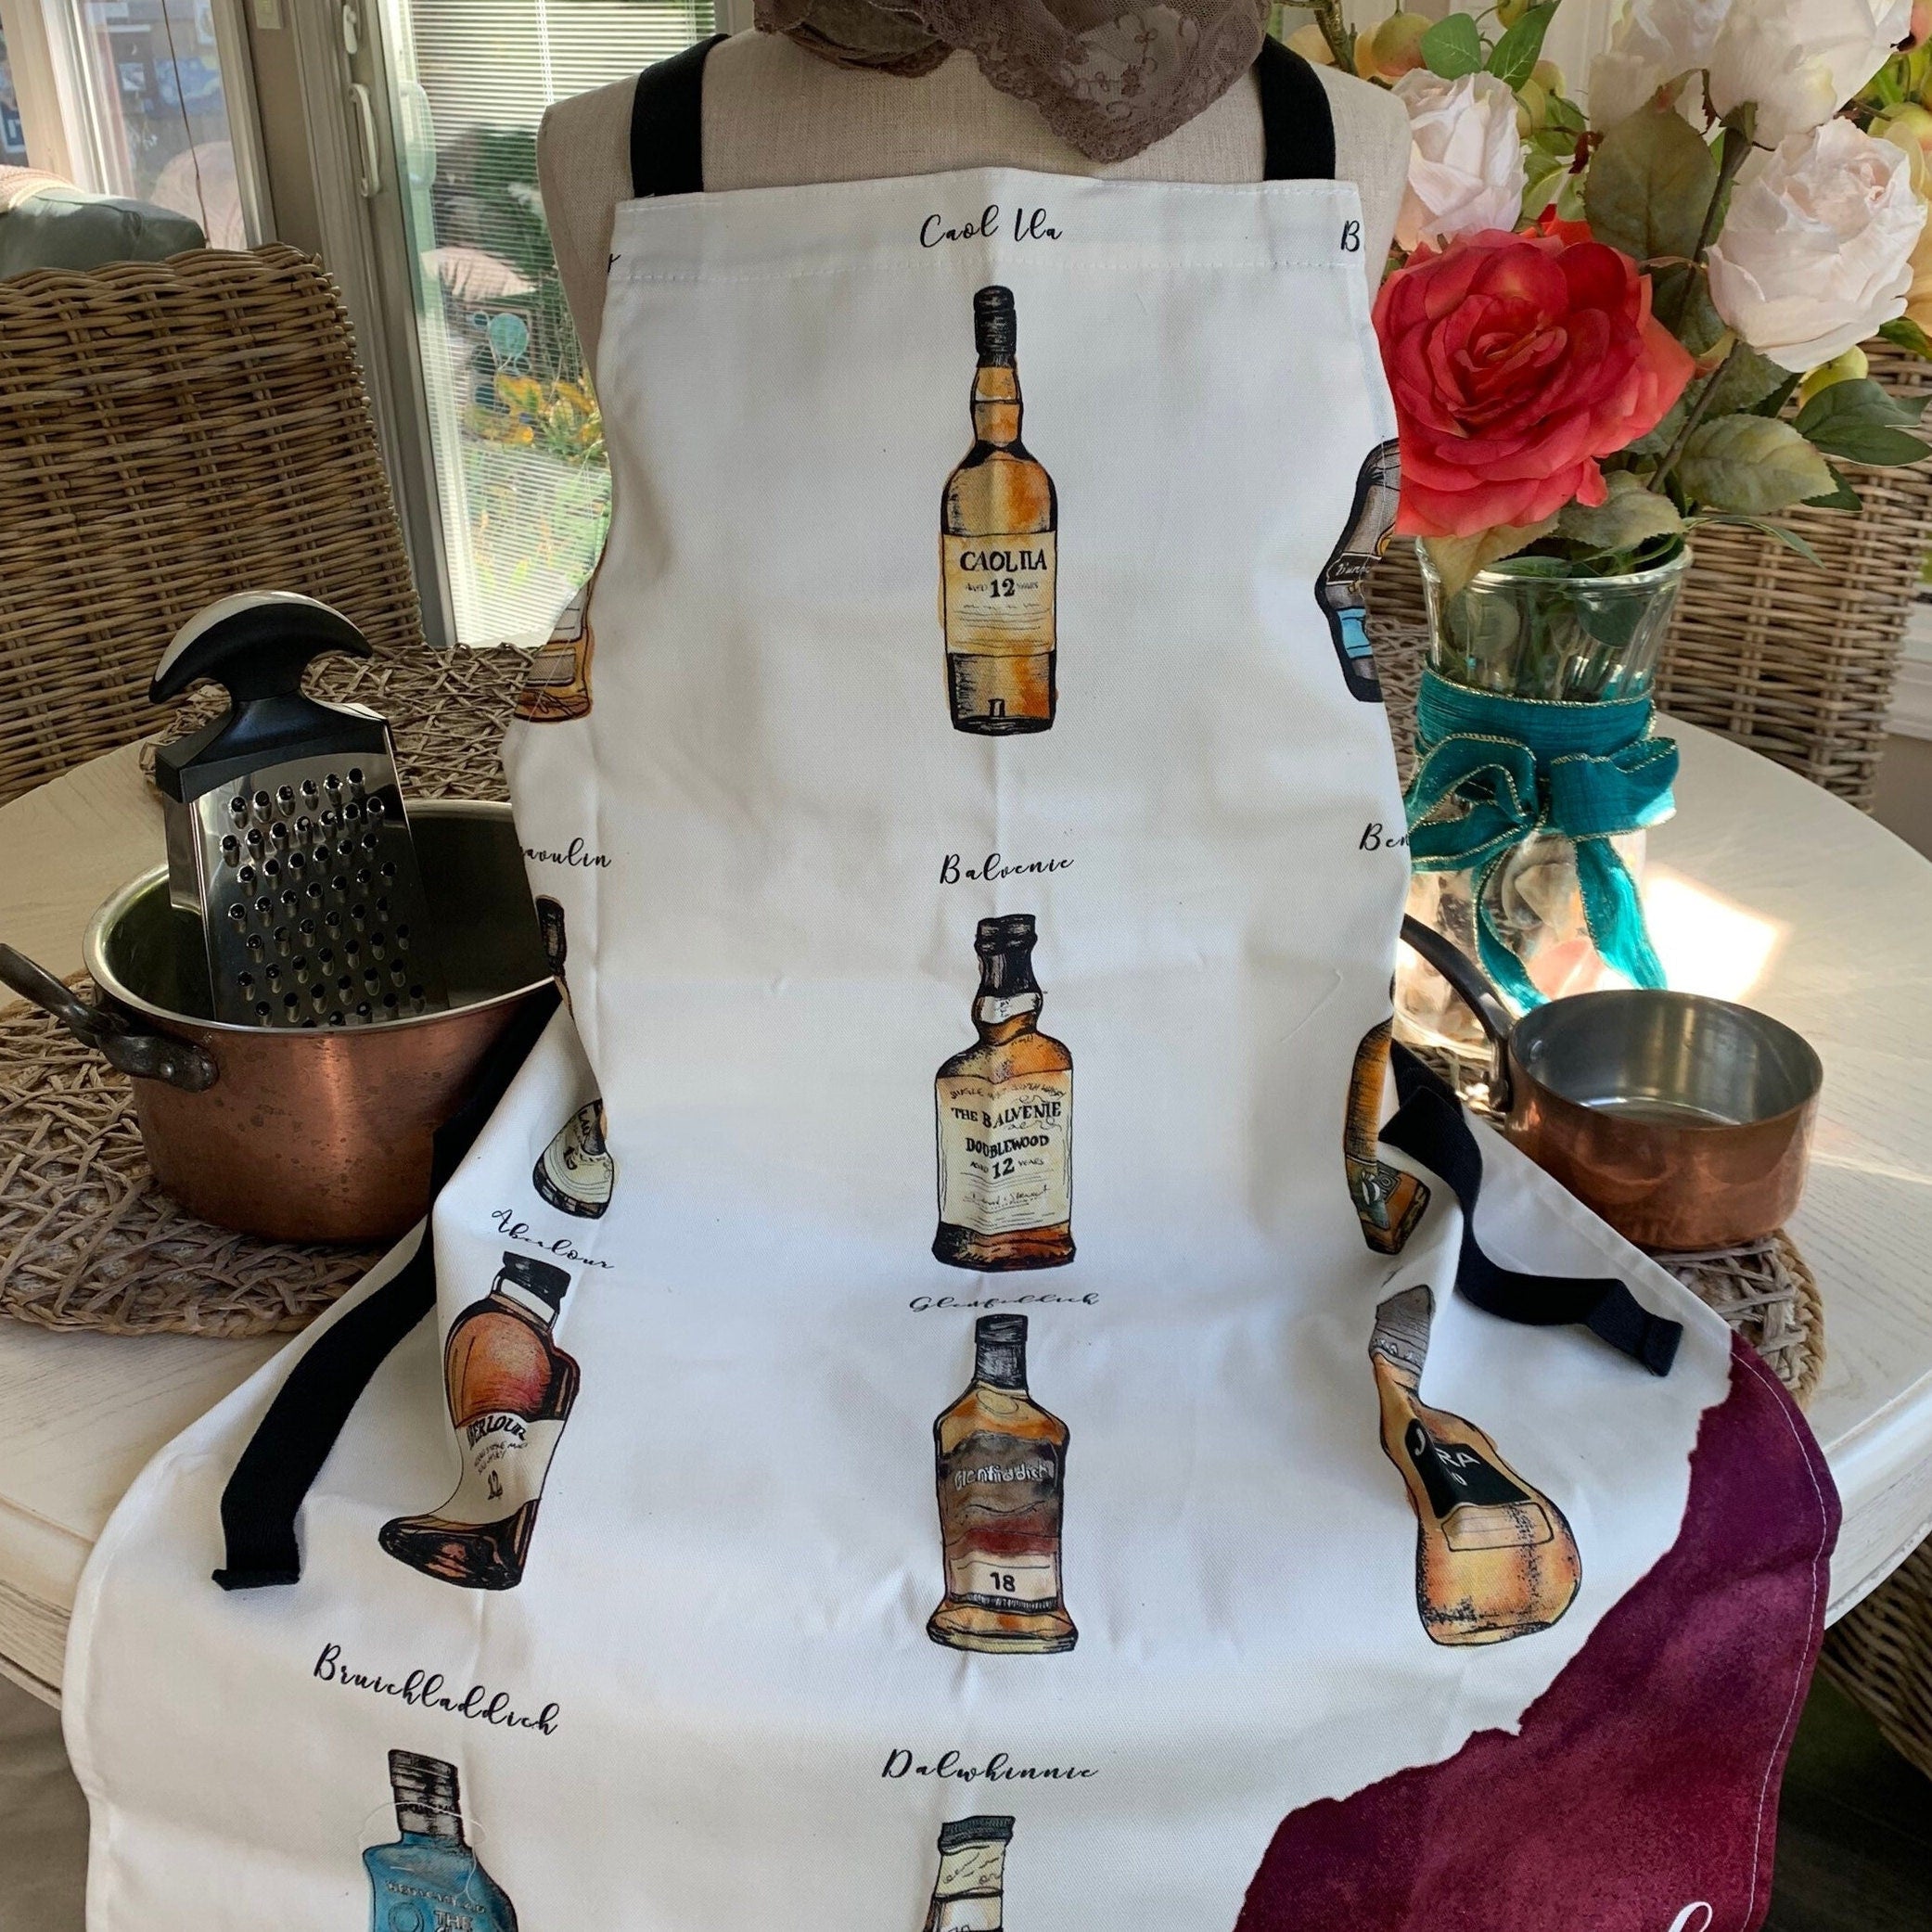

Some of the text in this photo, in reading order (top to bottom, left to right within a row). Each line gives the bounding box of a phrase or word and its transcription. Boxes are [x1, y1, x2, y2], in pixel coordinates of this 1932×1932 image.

[919, 204, 999, 249] Caol
[990, 577, 1016, 598] 12
[940, 852, 1075, 885] Balvenie
[951, 1100, 1062, 1130] THE BALVENIE
[965, 1134, 1051, 1160] DOUBLEWOOD
[992, 1157, 1016, 1180] 12
[491, 1208, 616, 1270] Aberlour
[990, 1571, 1017, 1593] 18
[313, 1642, 561, 1736] Bruichladdich
[881, 1747, 1099, 1783] Dalwhinnie
